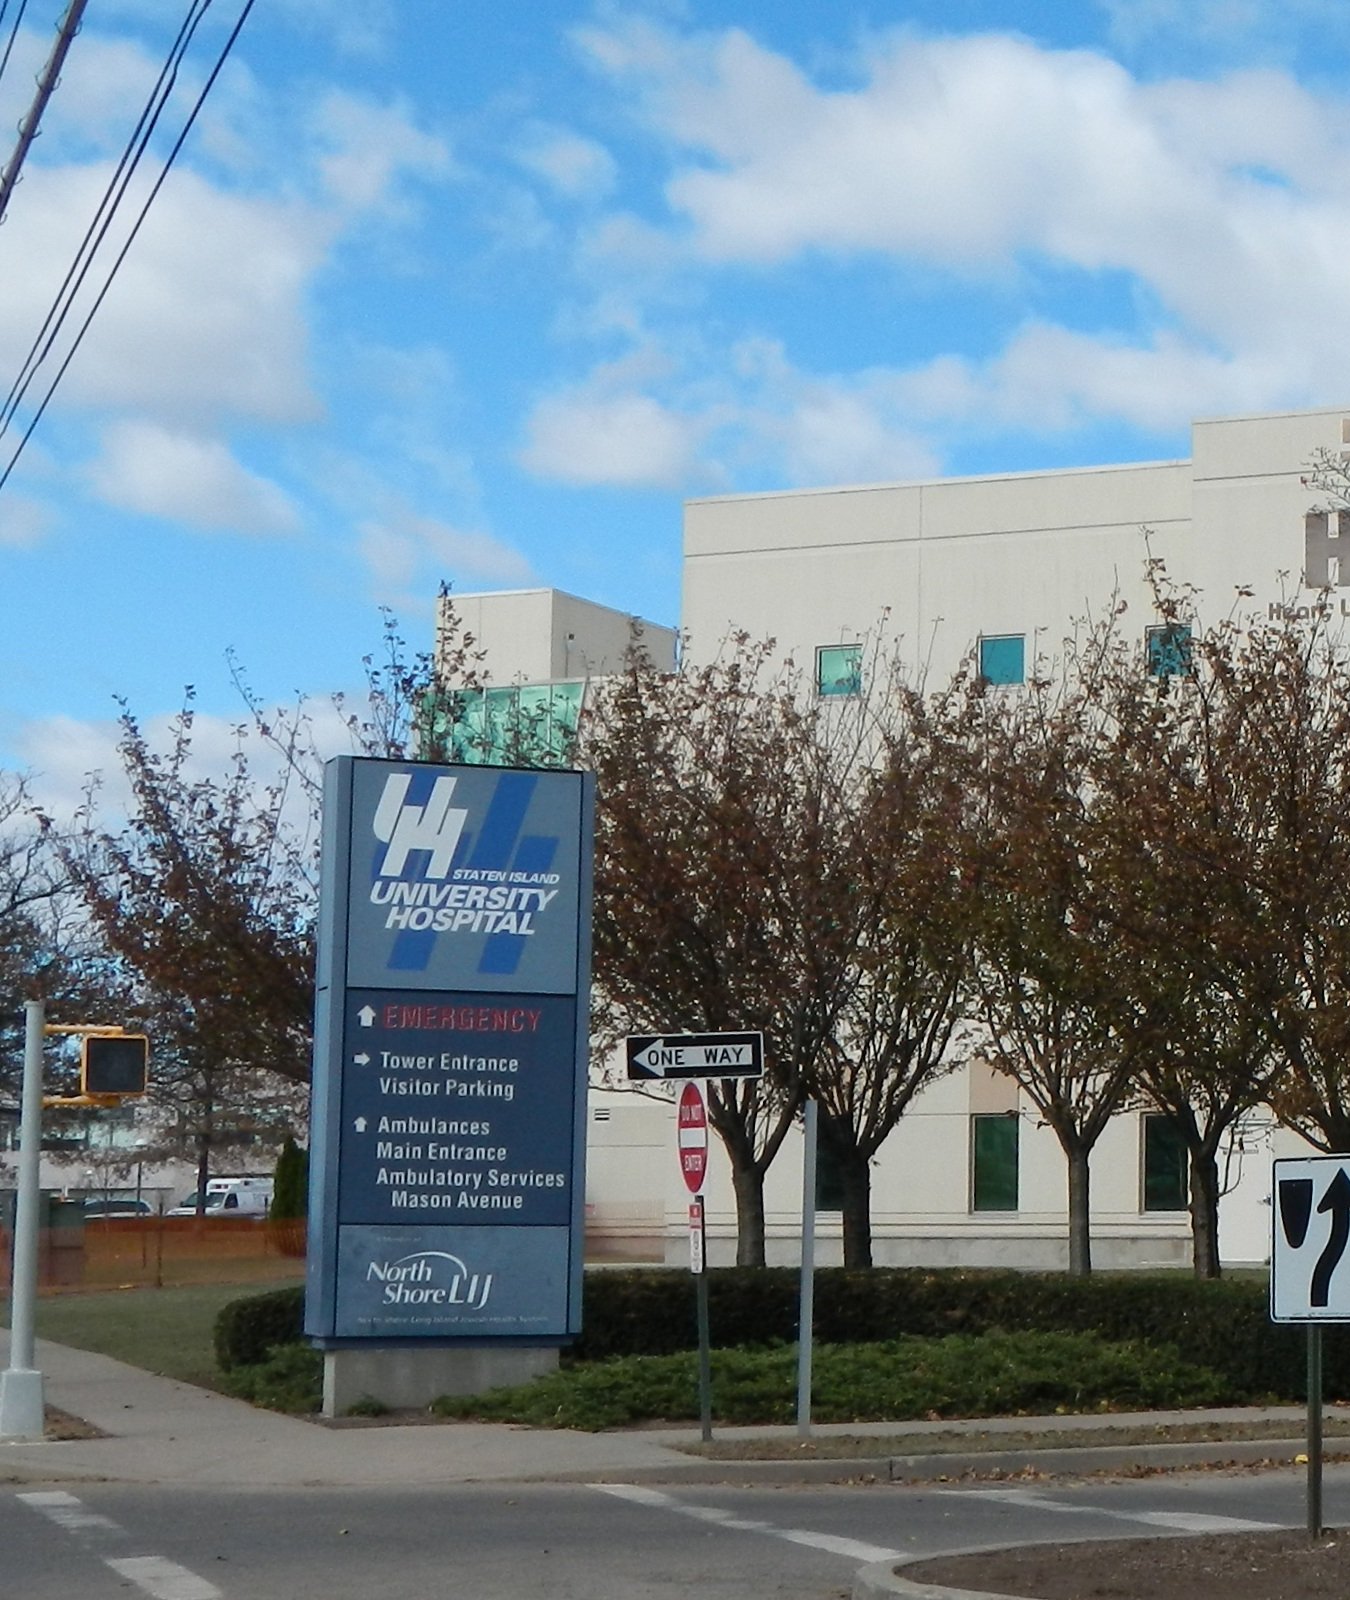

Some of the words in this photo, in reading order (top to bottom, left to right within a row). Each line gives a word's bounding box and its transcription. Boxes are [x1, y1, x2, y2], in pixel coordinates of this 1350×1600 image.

[452, 868, 507, 882] STATEN
[508, 871, 560, 885] ISLAND
[370, 881, 558, 912] UNIVERSITY
[385, 906, 535, 935] HOSPITAL
[383, 1004, 541, 1032] EMERGENCY
[380, 1051, 435, 1070] Tower
[440, 1053, 519, 1072] Entrance
[647, 1049, 685, 1067] ONE
[703, 1047, 744, 1065] WAY
[379, 1077, 440, 1096] Visitor
[446, 1079, 514, 1101] Parking
[377, 1116, 490, 1135] Ambulances
[377, 1141, 422, 1160] Main
[428, 1143, 507, 1161] Entrance
[376, 1168, 482, 1190] Ambulatory
[488, 1169, 565, 1187] Services
[391, 1190, 451, 1208] Mason
[457, 1191, 523, 1209] Avenue
[367, 1259, 432, 1282] North
[382, 1283, 446, 1305] Shore
[448, 1274, 493, 1310] LIJ
